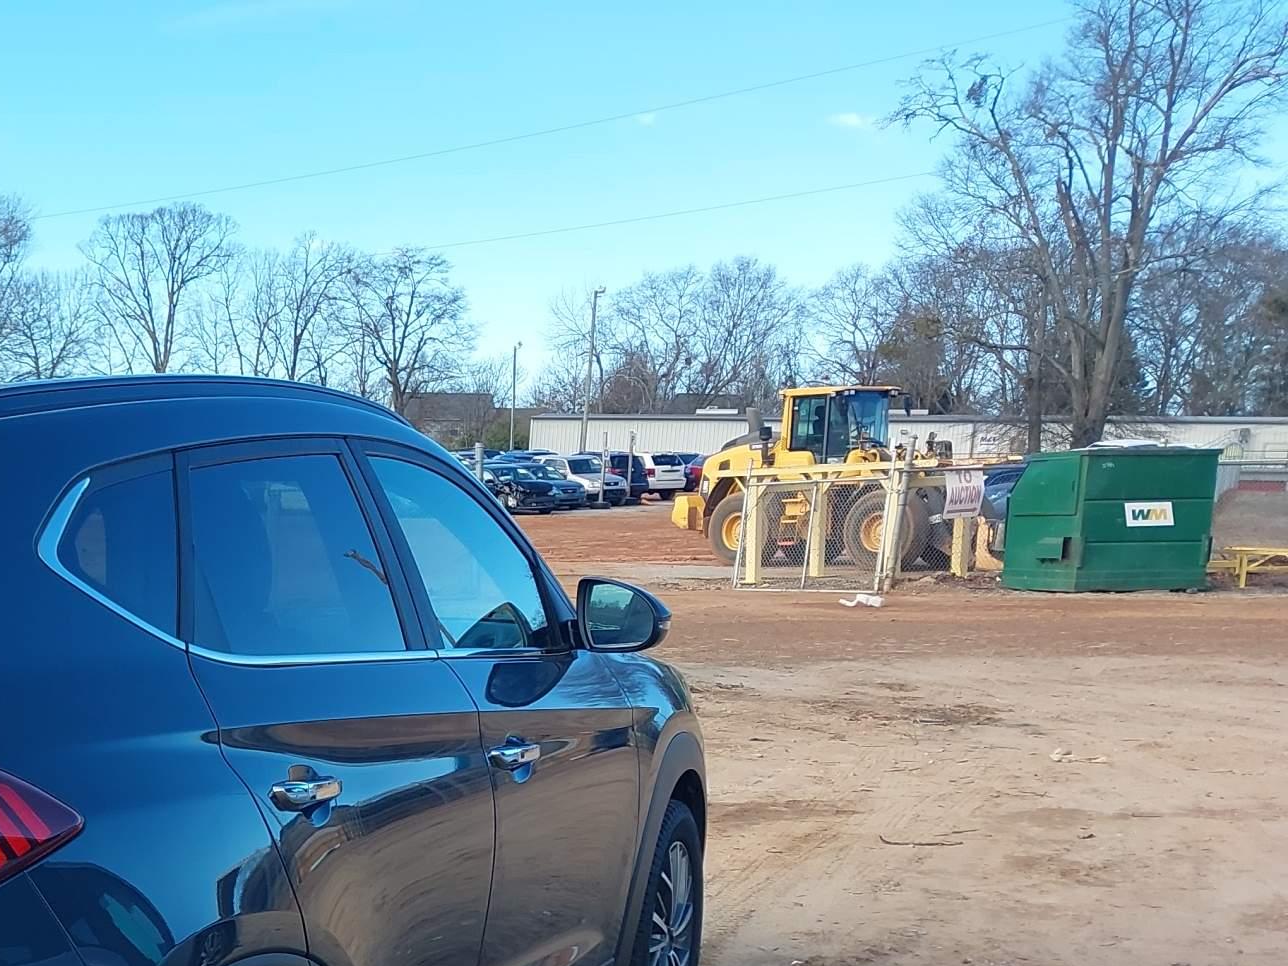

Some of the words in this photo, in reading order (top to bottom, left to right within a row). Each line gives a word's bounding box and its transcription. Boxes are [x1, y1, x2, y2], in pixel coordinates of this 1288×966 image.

[955, 470, 972, 484] TO
[948, 485, 982, 506] AUCTION
[1131, 508, 1169, 521] WM
